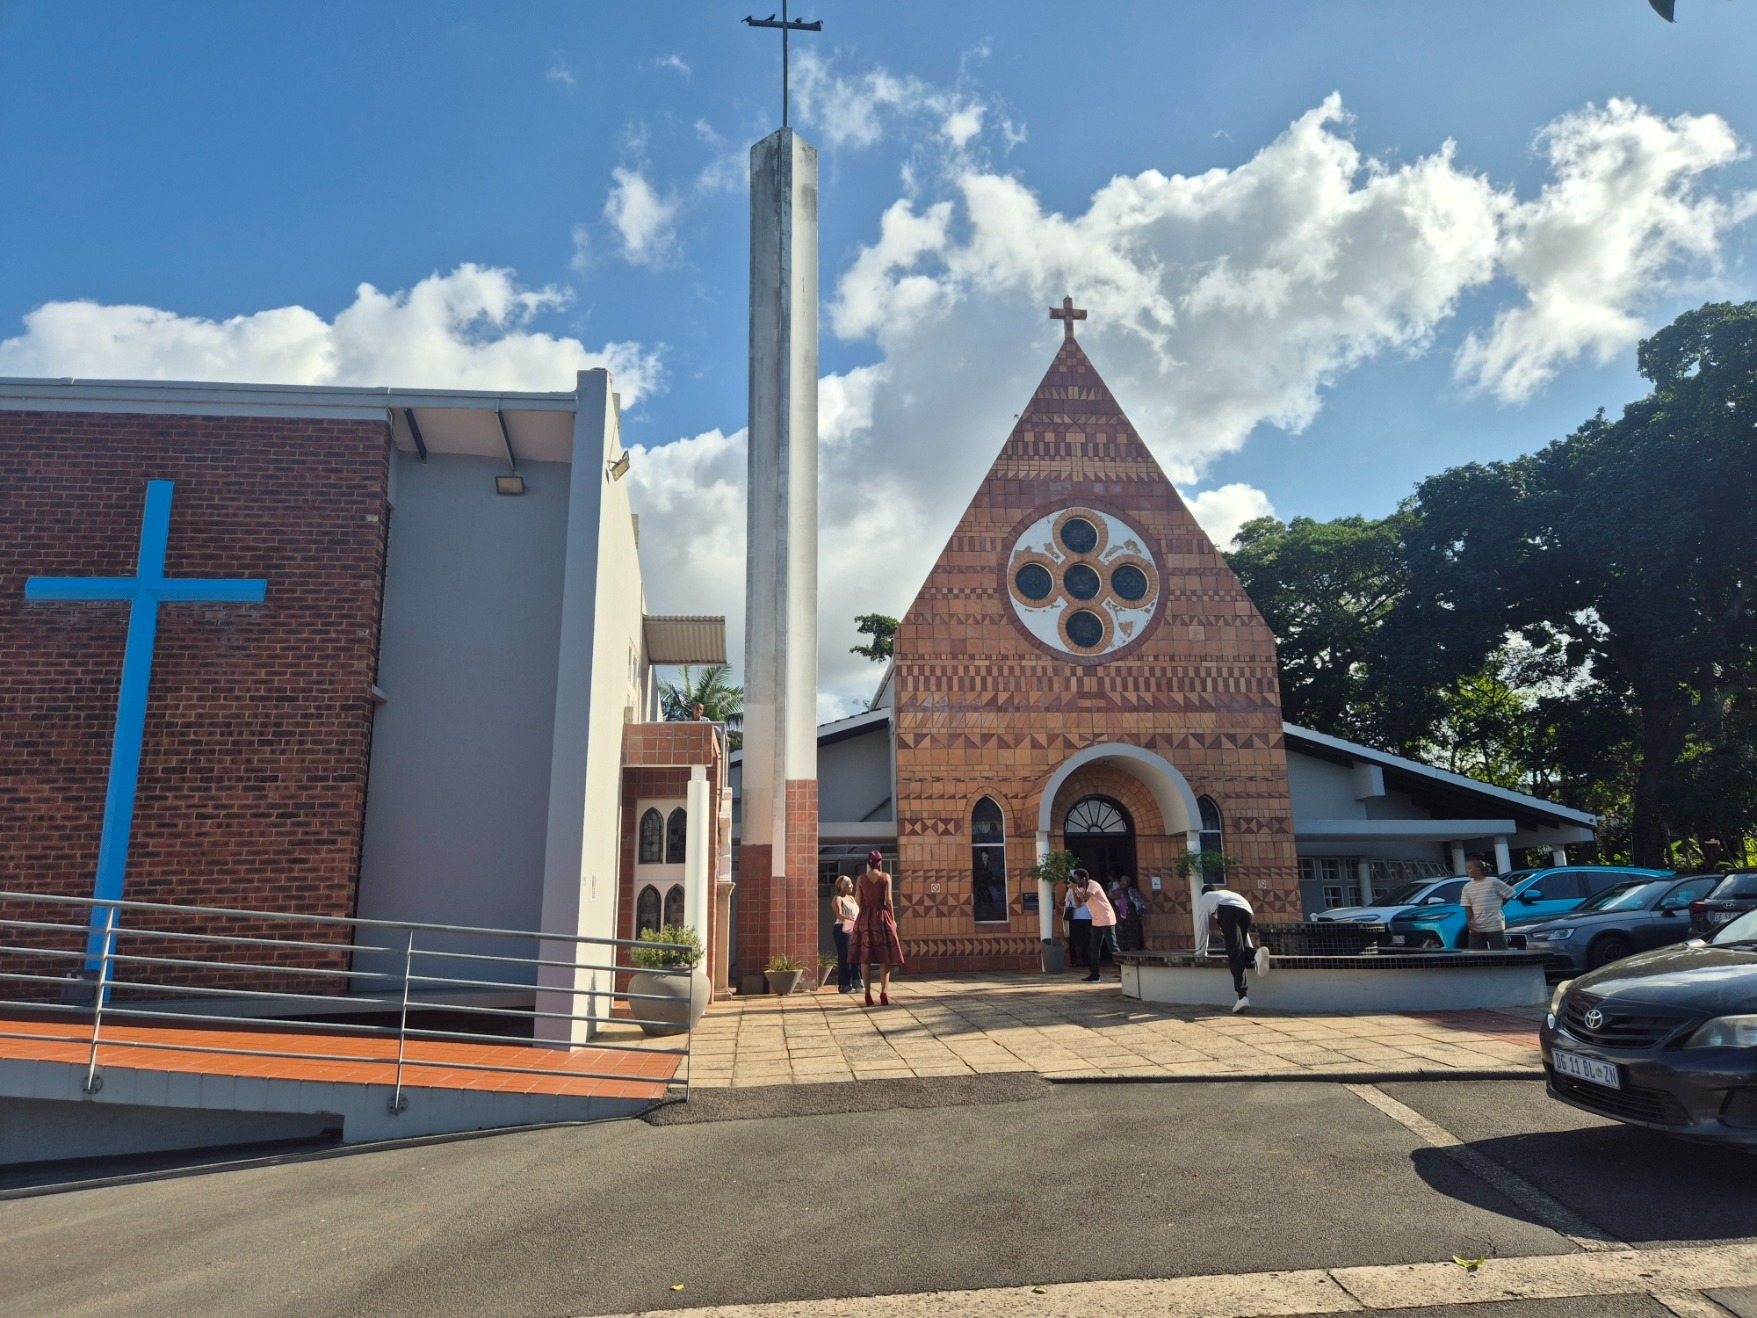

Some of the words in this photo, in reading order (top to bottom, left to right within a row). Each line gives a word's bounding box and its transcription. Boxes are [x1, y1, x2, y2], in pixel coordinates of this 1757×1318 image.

[1569, 1056, 1581, 1075] 11
[1583, 1060, 1595, 1079] BL
[1603, 1065, 1617, 1085] ZN
